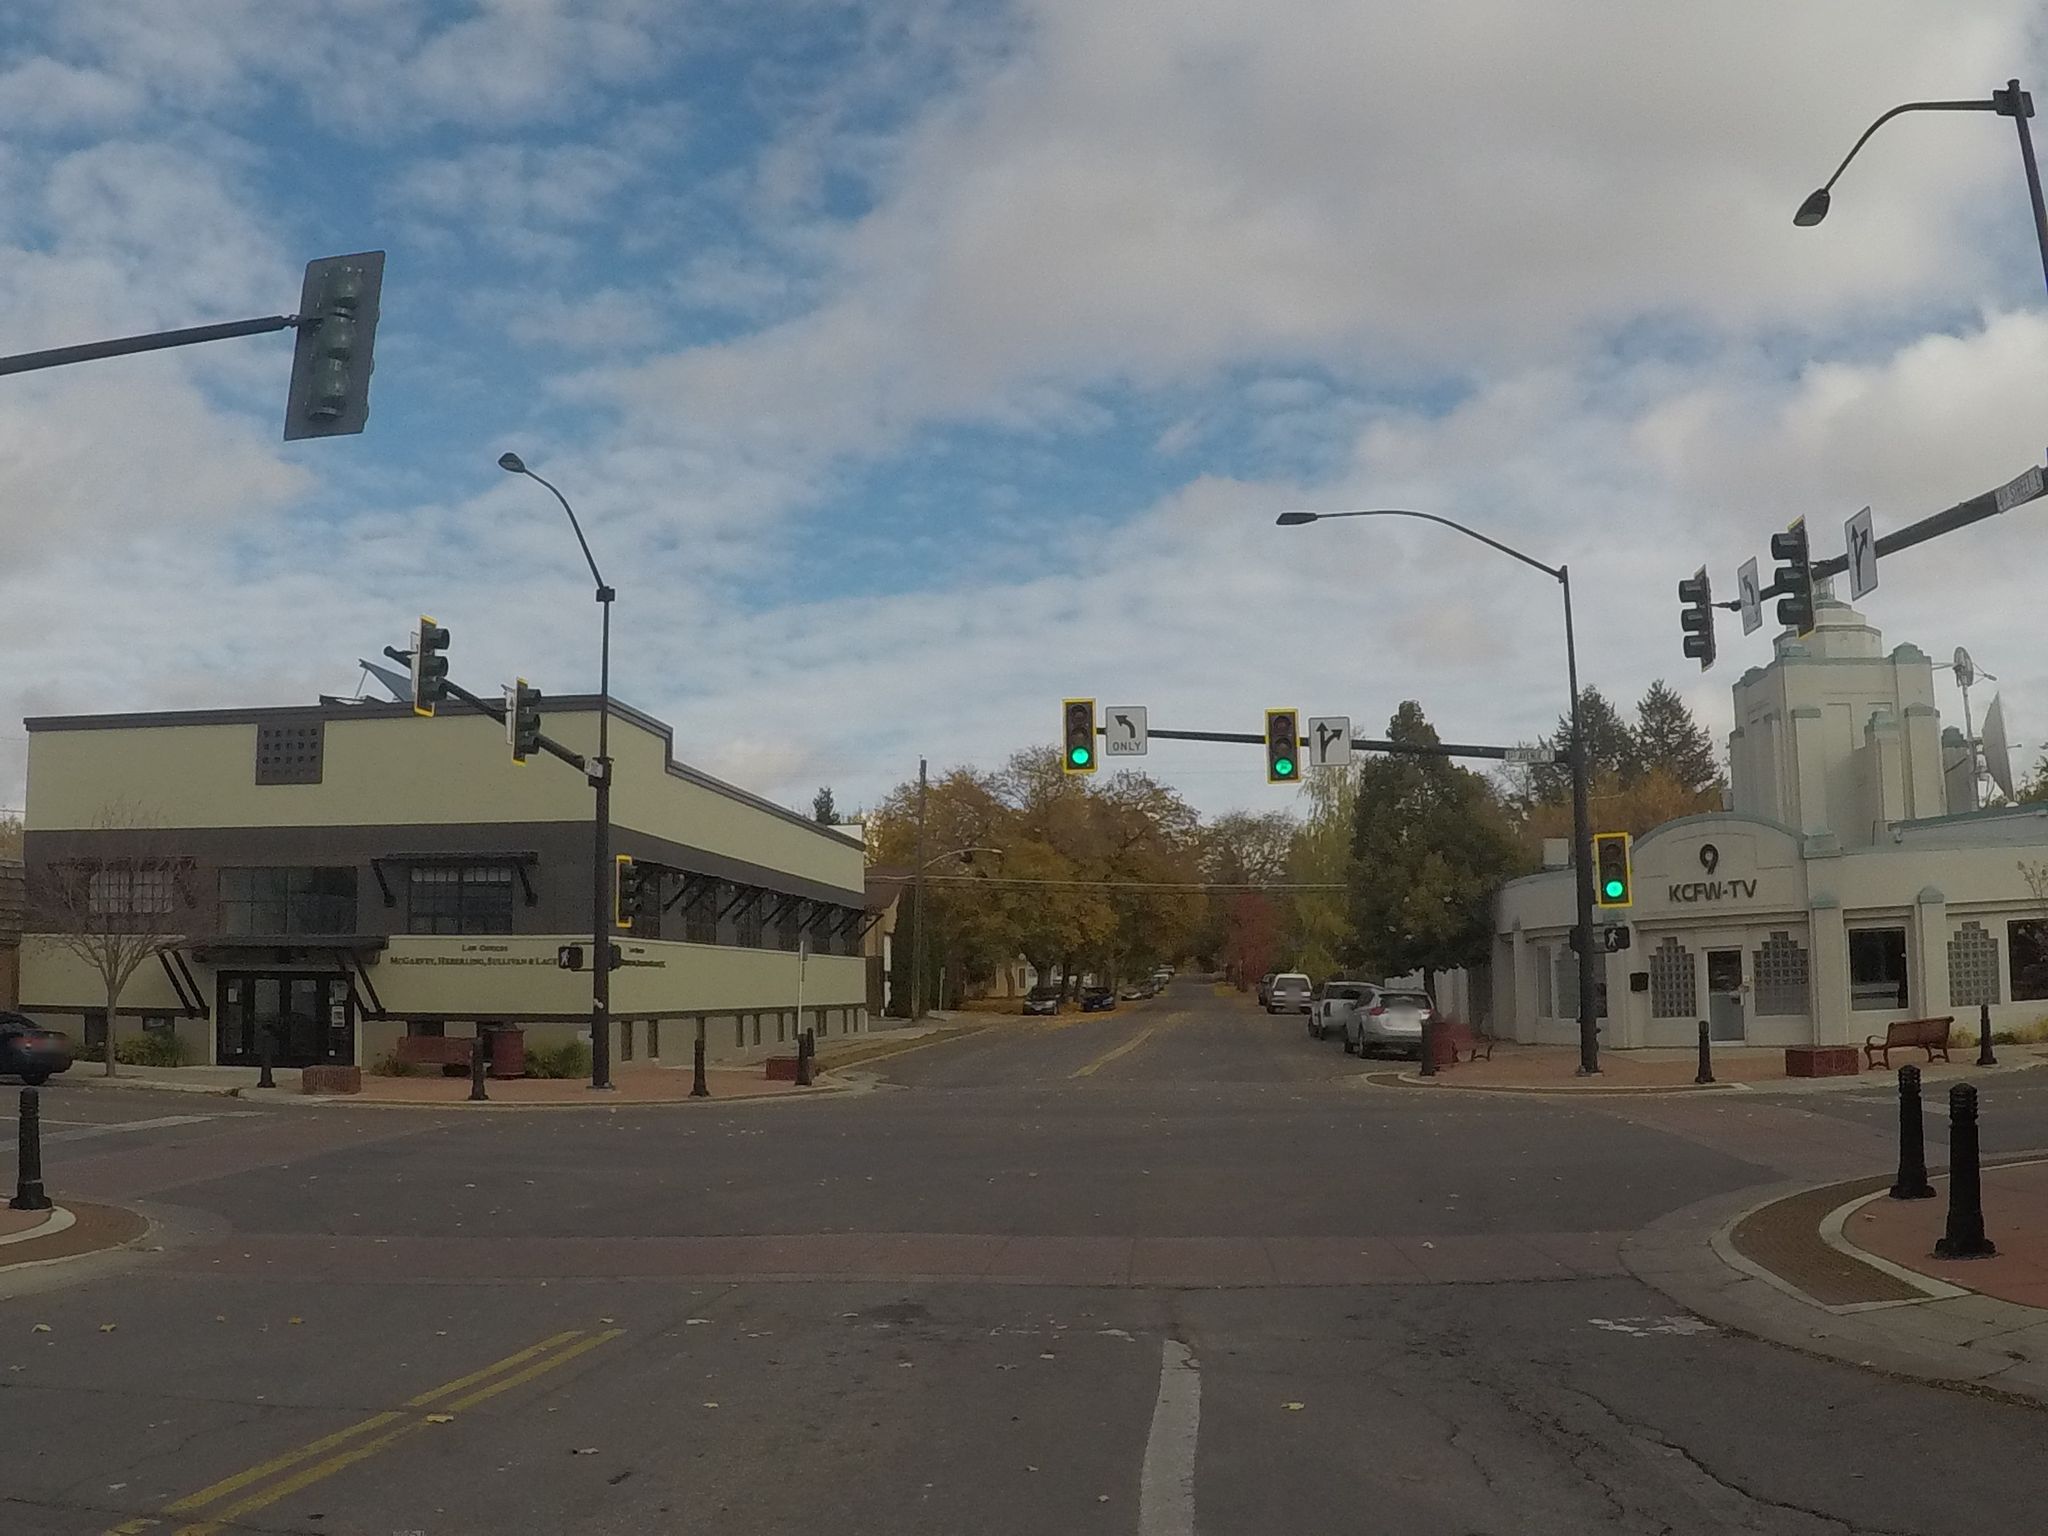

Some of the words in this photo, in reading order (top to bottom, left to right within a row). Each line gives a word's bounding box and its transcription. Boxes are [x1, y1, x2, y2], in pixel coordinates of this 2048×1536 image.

[1112, 741, 1141, 751] ONLY
[1699, 844, 1719, 875] 9
[1668, 879, 1758, 902] KCFW-TV
